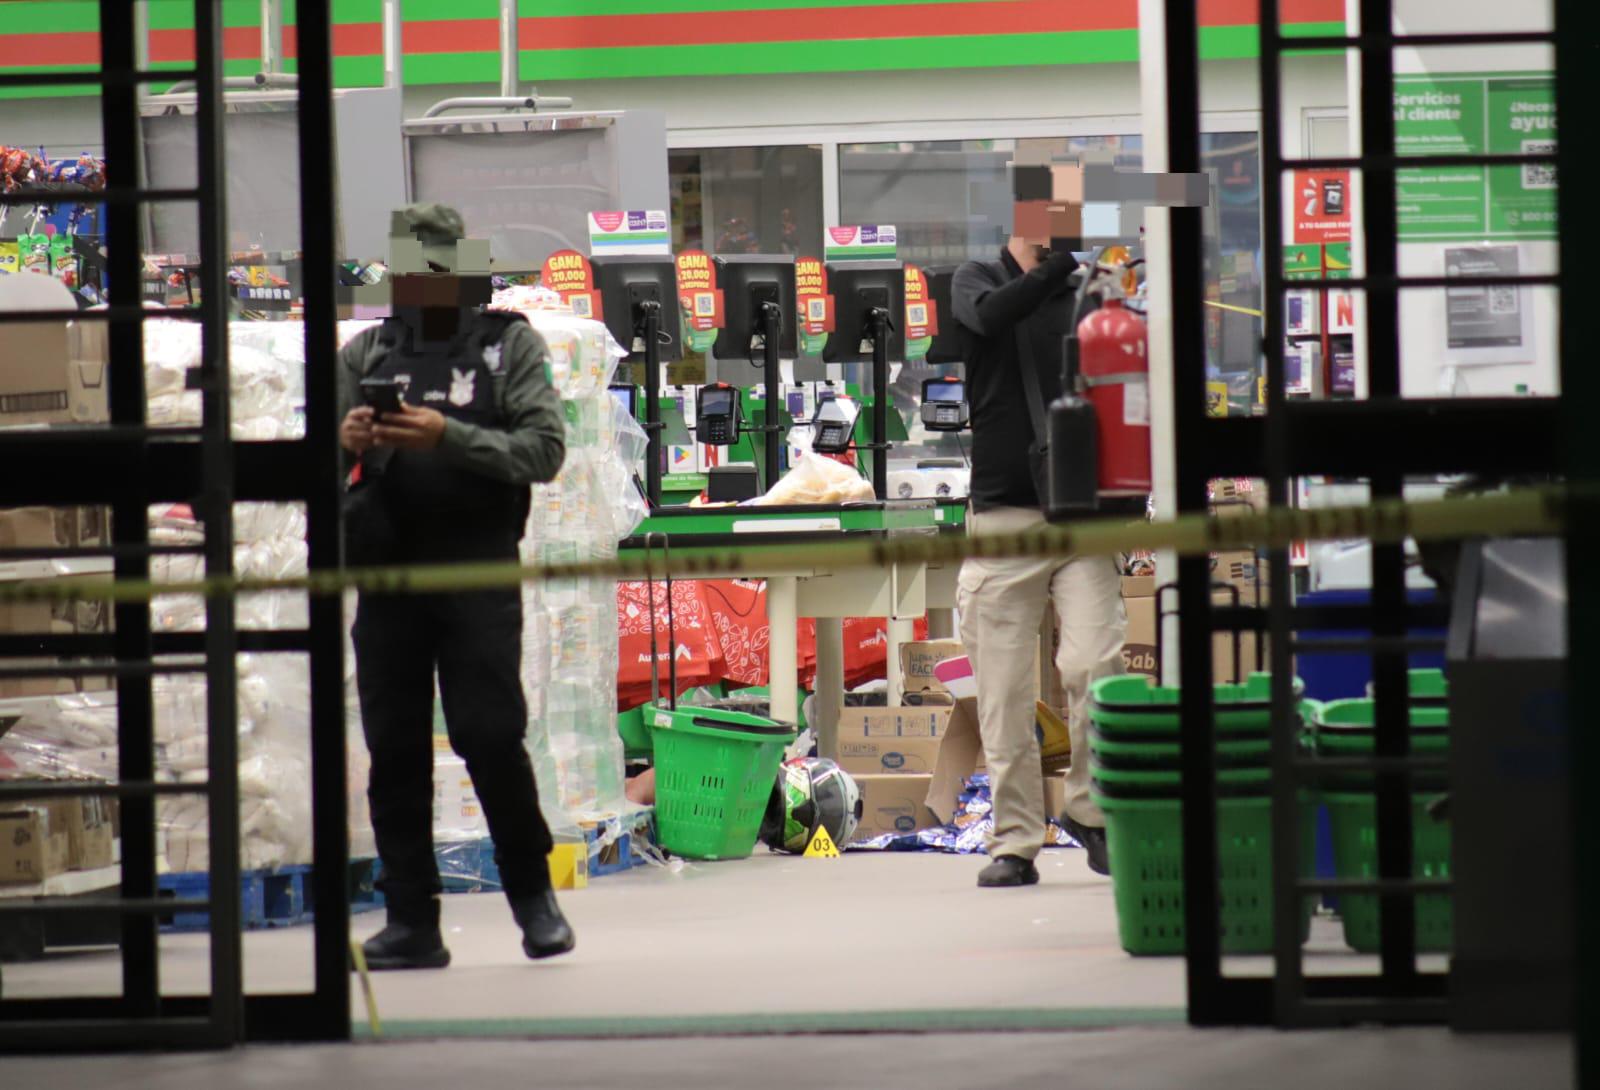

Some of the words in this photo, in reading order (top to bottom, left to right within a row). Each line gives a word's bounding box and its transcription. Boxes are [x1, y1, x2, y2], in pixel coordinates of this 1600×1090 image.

[1408, 107, 1461, 121] cliente
[549, 256, 583, 270] GANA
[678, 255, 708, 269] GANA
[552, 270, 586, 283] 20,000
[681, 270, 710, 281] 20,000
[1122, 649, 1157, 669] Sab
[813, 839, 830, 851] 03
